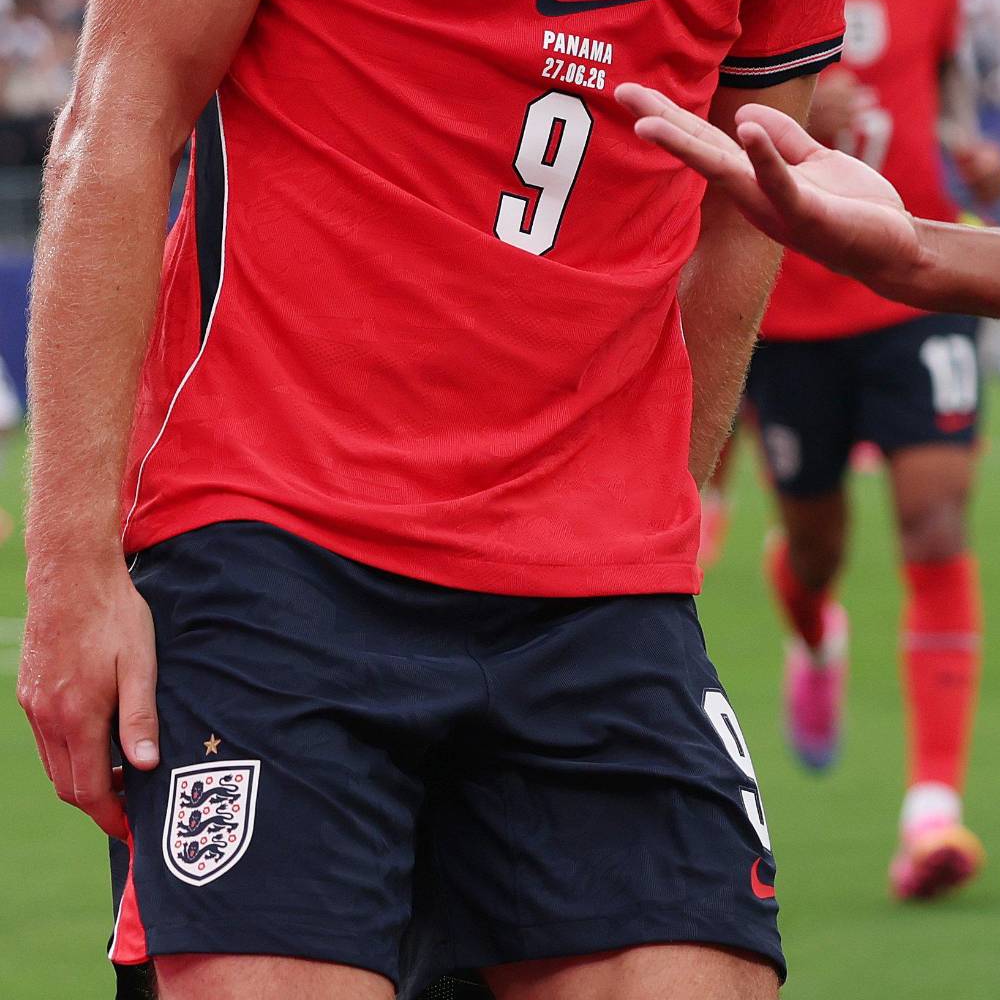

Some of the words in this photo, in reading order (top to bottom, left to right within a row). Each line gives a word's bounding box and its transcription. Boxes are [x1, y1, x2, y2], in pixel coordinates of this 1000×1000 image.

[541, 57, 606, 90] 27.06.26
[543, 30, 613, 65] PANAMA
[493, 89, 595, 256] 9
[701, 688, 772, 855] 9
